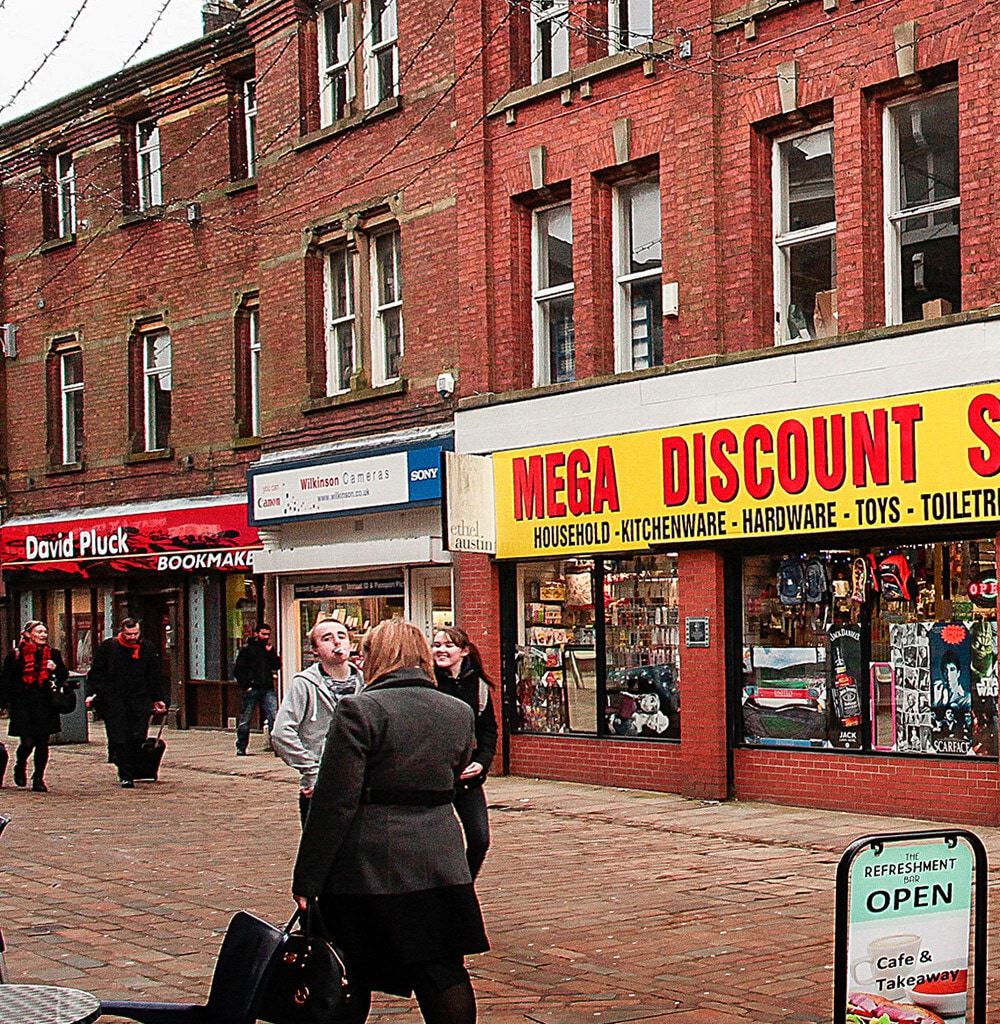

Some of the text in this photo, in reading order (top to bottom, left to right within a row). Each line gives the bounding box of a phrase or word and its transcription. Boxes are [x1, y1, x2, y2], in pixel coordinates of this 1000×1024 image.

[512, 445, 621, 521] MEGA
[661, 403, 924, 507] DISCOUNT
[299, 468, 391, 491] Wilkinson Cameras
[410, 467, 439, 482] SONY
[257, 497, 282, 509] Canon
[450, 519, 480, 537] ethel
[533, 520, 611, 549] HOUSEHOLD
[742, 501, 838, 535] HARDWARE
[855, 495, 901, 526] TOYS
[25, 526, 130, 560] David Pluck
[455, 535, 493, 552] austin
[839, 731, 857, 739] JACK
[933, 739, 971, 754] SCARFACE
[905, 852, 920, 861] THE
[864, 858, 957, 878] REFRESHMENT
[903, 875, 920, 884] BAR
[865, 882, 953, 913] OPEN
[876, 950, 933, 970] Cafe &
[875, 969, 960, 992] Takeaway
